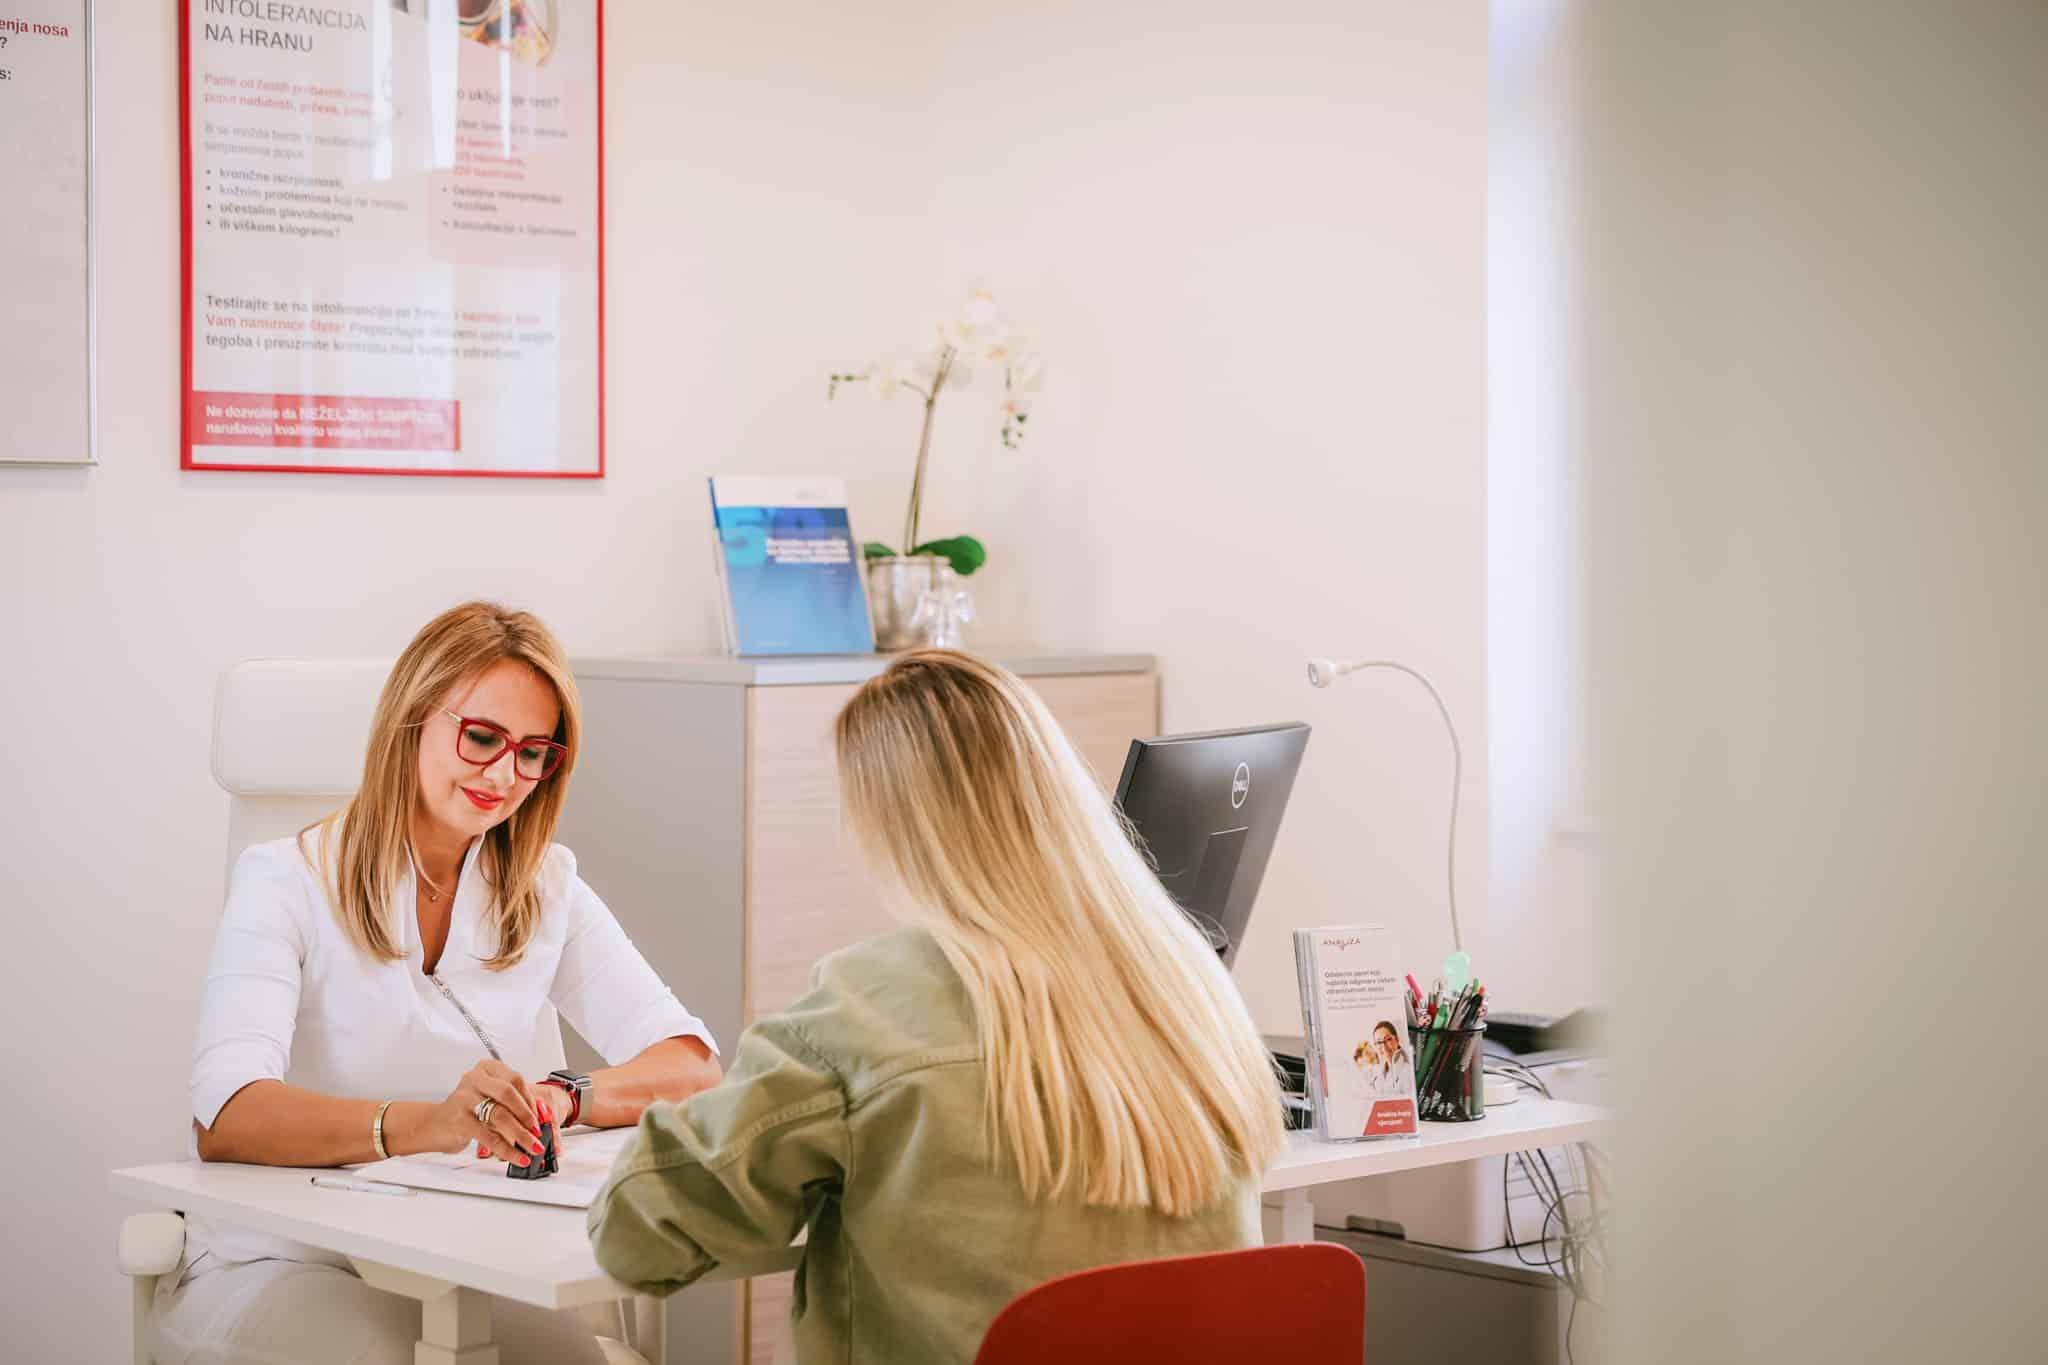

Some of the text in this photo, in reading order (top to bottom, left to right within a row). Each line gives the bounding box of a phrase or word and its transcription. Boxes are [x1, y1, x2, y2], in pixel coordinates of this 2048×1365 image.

[205, 0, 367, 31] INTOLERANCIJA
[33, 23, 69, 37] nosa
[205, 23, 314, 52] NA HRANU
[232, 219, 277, 232] viškom
[206, 295, 268, 313] Testirajte
[273, 301, 289, 312] se
[292, 302, 308, 313] na
[206, 314, 237, 329] Vam
[206, 333, 253, 350] tegoba
[1322, 936, 1361, 947] ANALIZA
